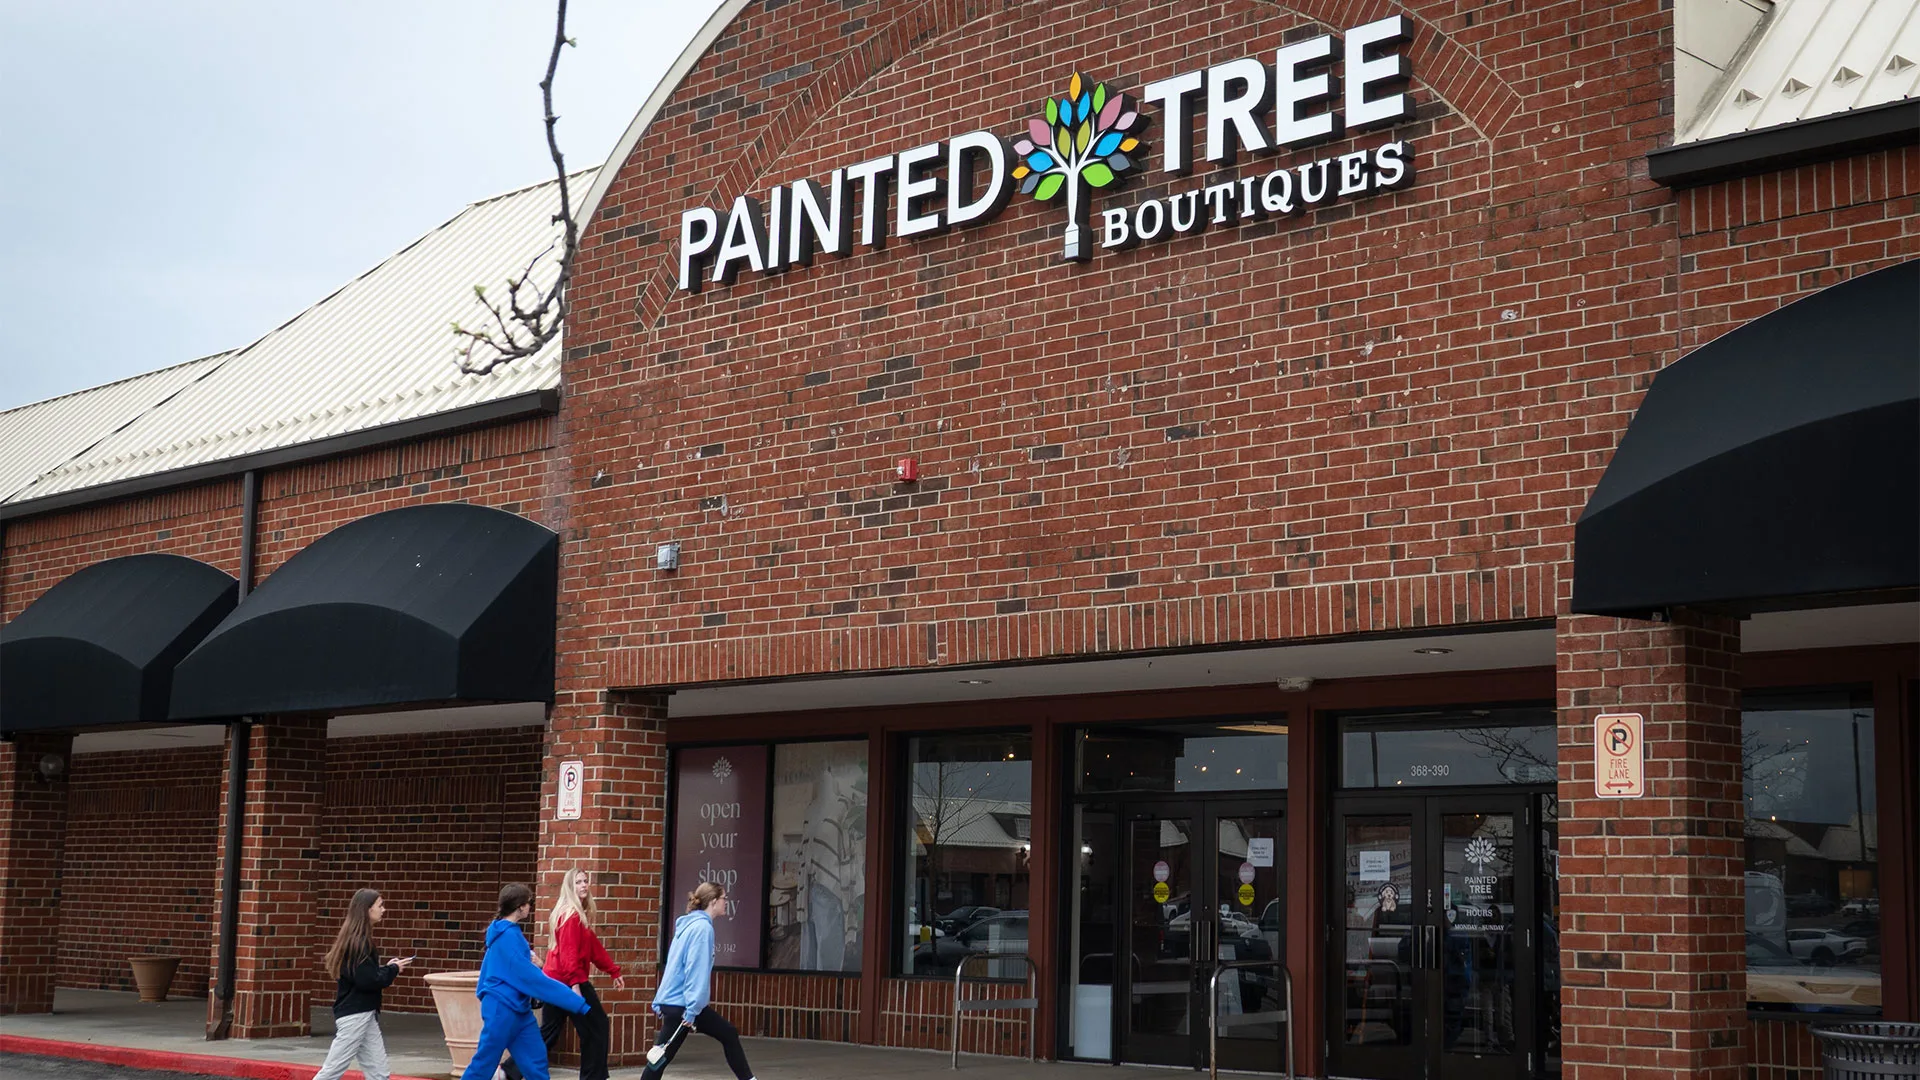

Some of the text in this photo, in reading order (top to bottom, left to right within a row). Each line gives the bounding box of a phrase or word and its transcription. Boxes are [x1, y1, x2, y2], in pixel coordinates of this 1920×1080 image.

[679, 14, 1405, 291] PAINTED TREE
[1101, 140, 1405, 249] BOUTIQUES
[1610, 758, 1628, 769] FIRE
[1410, 764, 1450, 777] 368-390
[1608, 769, 1630, 780] LANE
[700, 802, 741, 826] open
[699, 832, 738, 854] your
[698, 861, 738, 893] shop
[1464, 876, 1498, 885] PAINTED
[1469, 885, 1492, 894] TREE
[1466, 909, 1493, 917] HOURS
